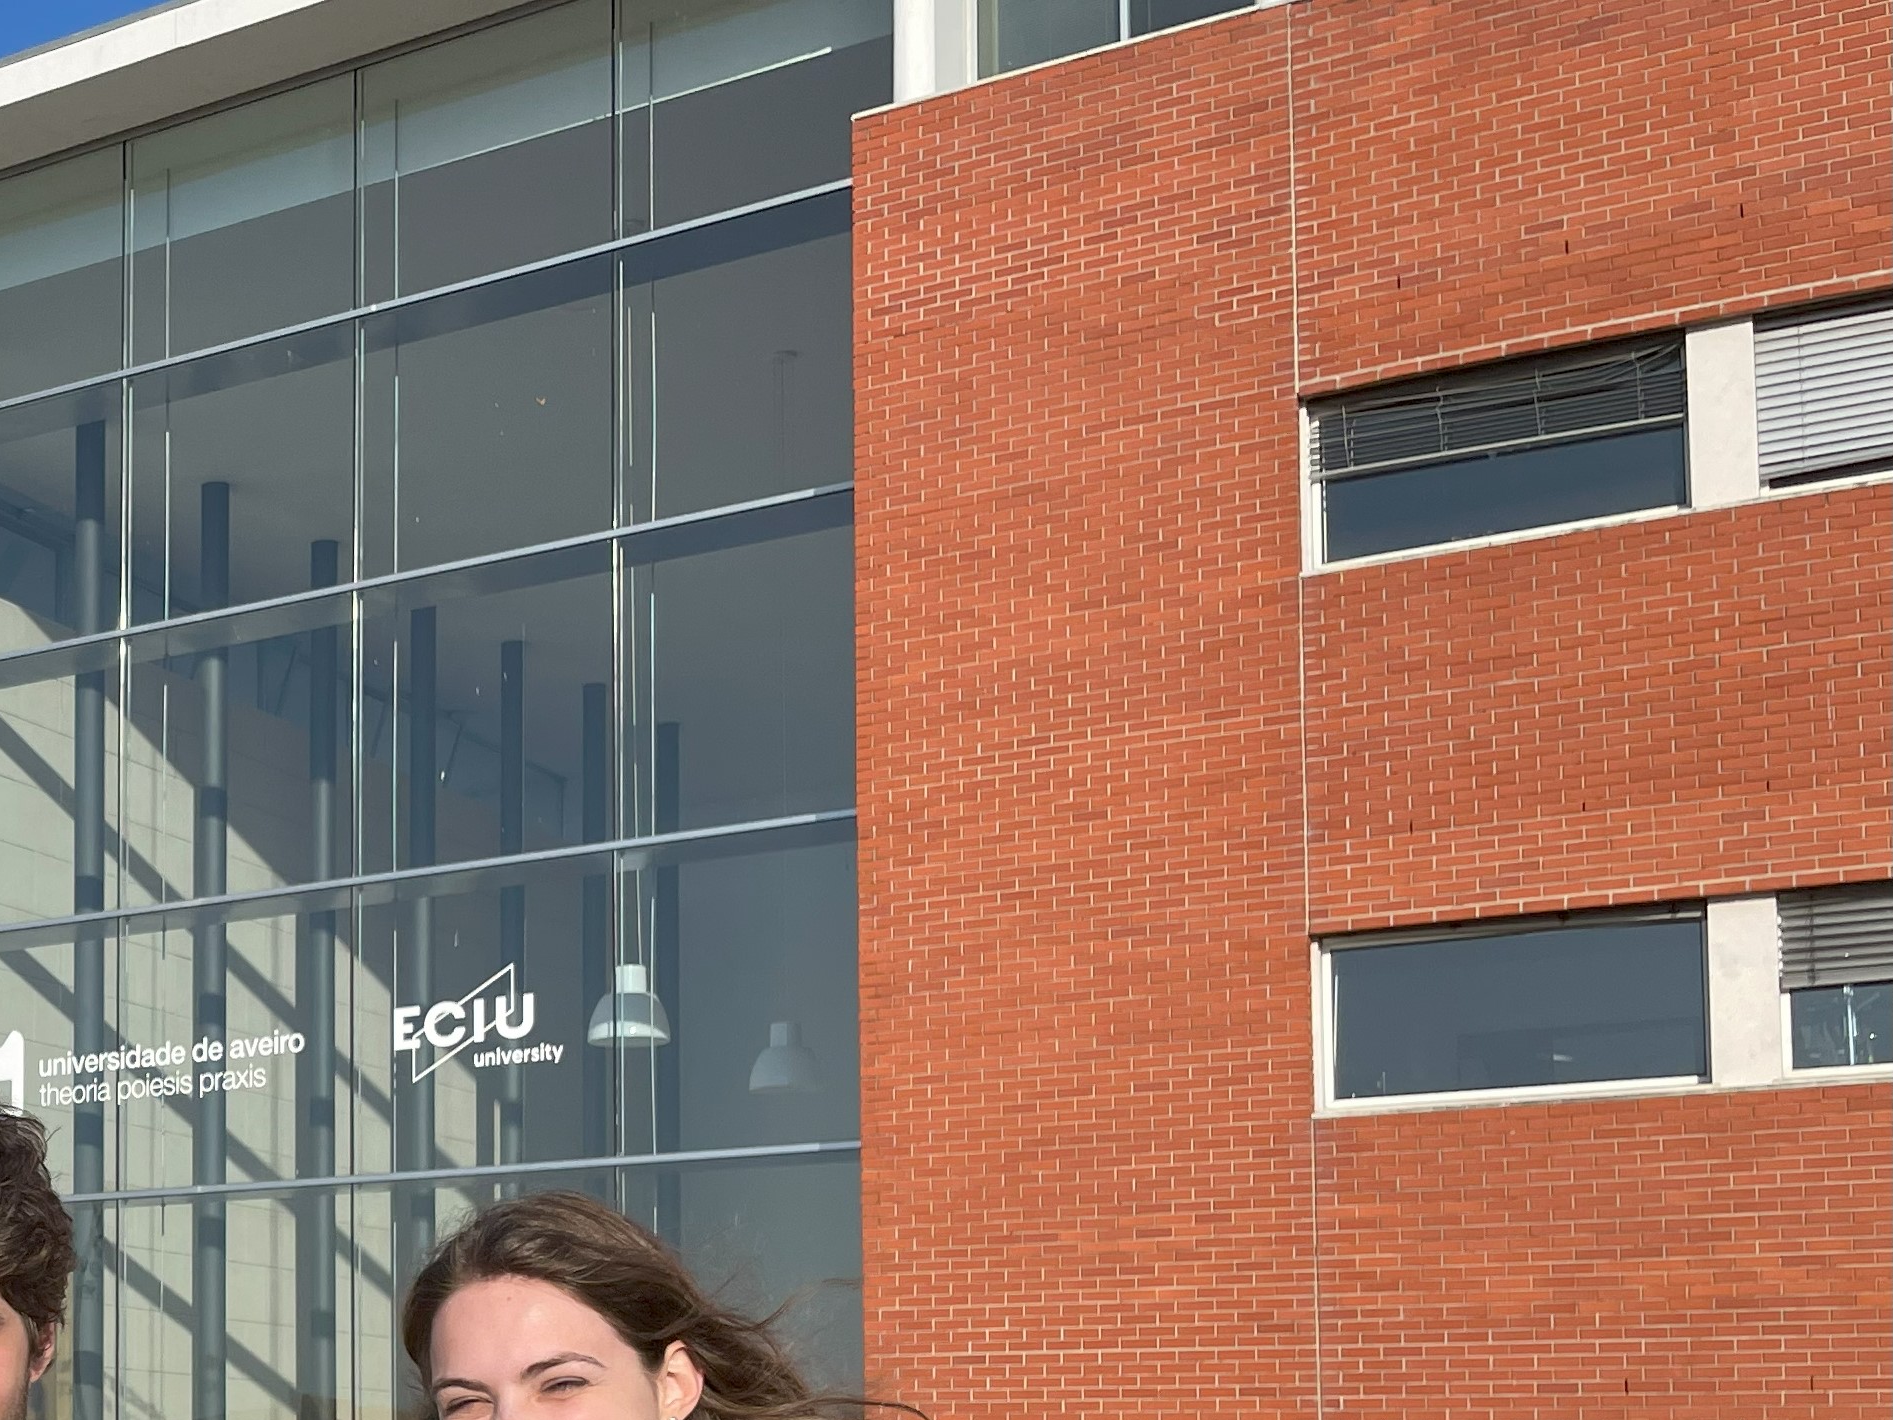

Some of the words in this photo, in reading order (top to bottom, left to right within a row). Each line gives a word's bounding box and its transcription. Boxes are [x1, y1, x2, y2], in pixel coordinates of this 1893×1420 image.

[394, 992, 535, 1051] ECIU
[38, 1041, 186, 1078] universidade
[192, 1036, 224, 1063] de
[229, 1029, 306, 1060] aveiro
[474, 1042, 564, 1068] university
[39, 1077, 111, 1107] theoria
[117, 1071, 193, 1105] poiesis
[200, 1063, 267, 1099] praxis
